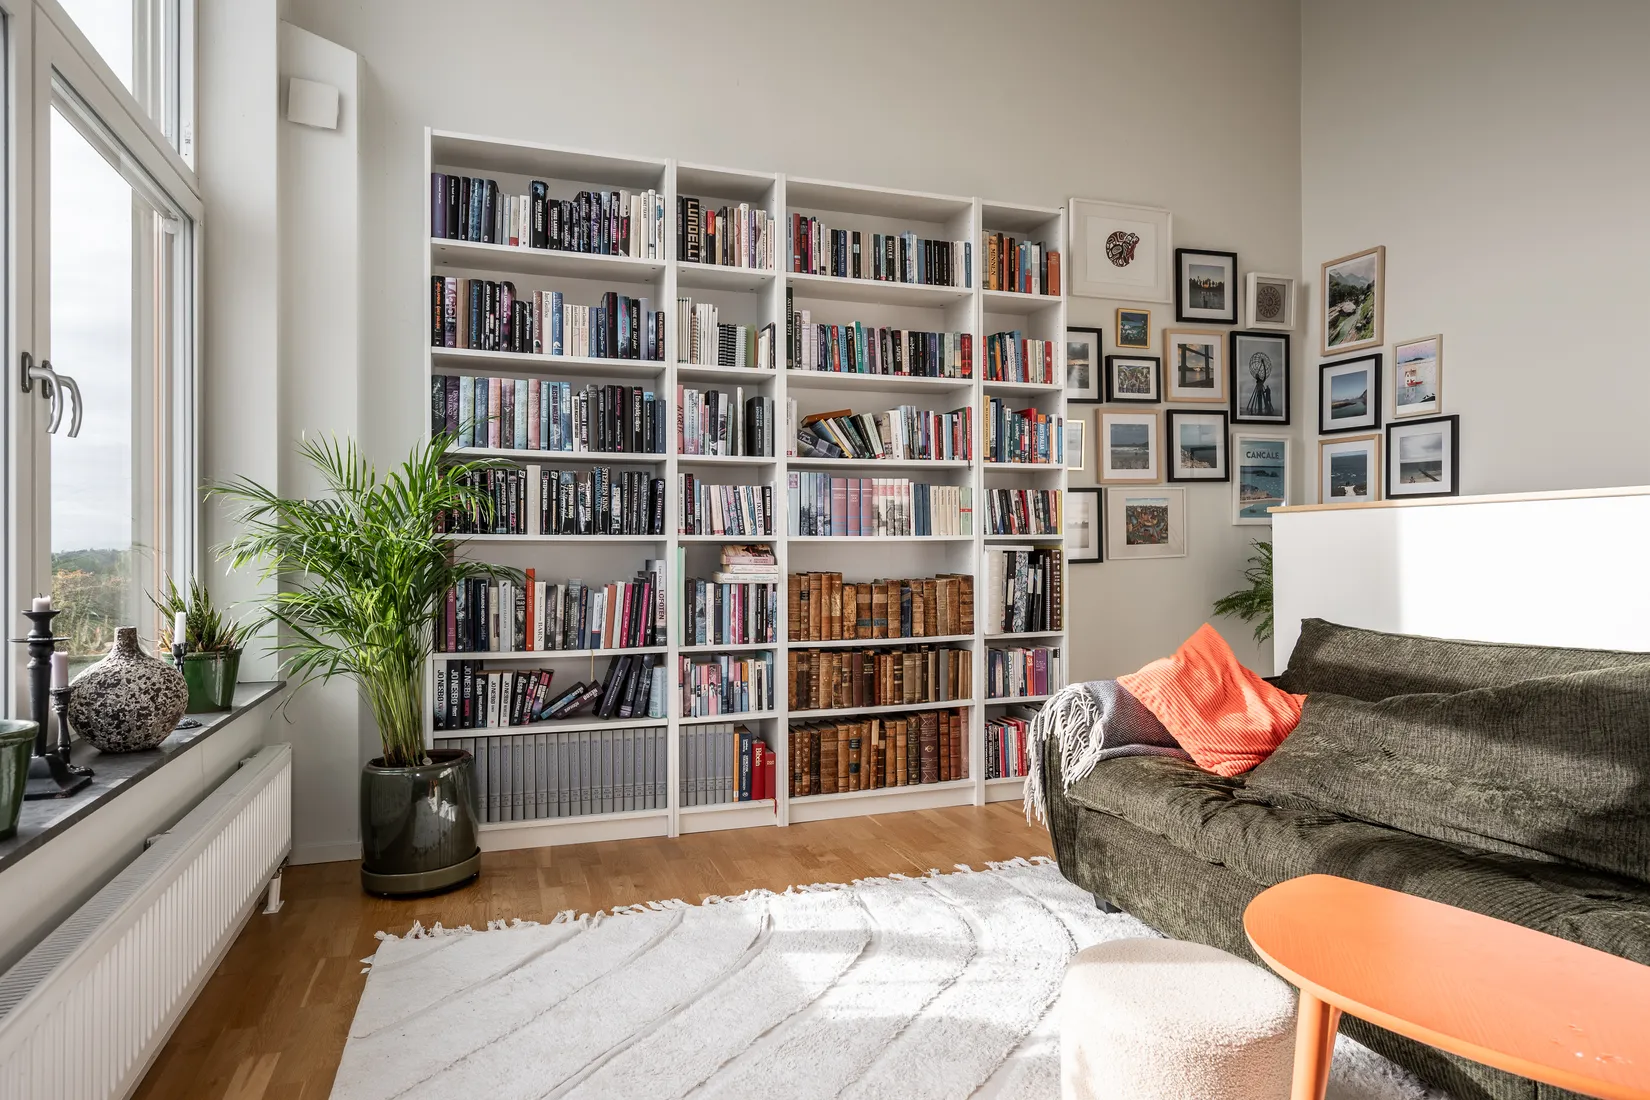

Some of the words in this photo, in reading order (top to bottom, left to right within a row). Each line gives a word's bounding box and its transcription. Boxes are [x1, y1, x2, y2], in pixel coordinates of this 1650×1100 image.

[688, 200, 698, 257] LUNDELL
[1246, 451, 1280, 459] CANCALE
[438, 670, 445, 679] JO
[451, 669, 459, 679] JO
[464, 665, 471, 675] JO
[451, 680, 459, 704] NESBØ
